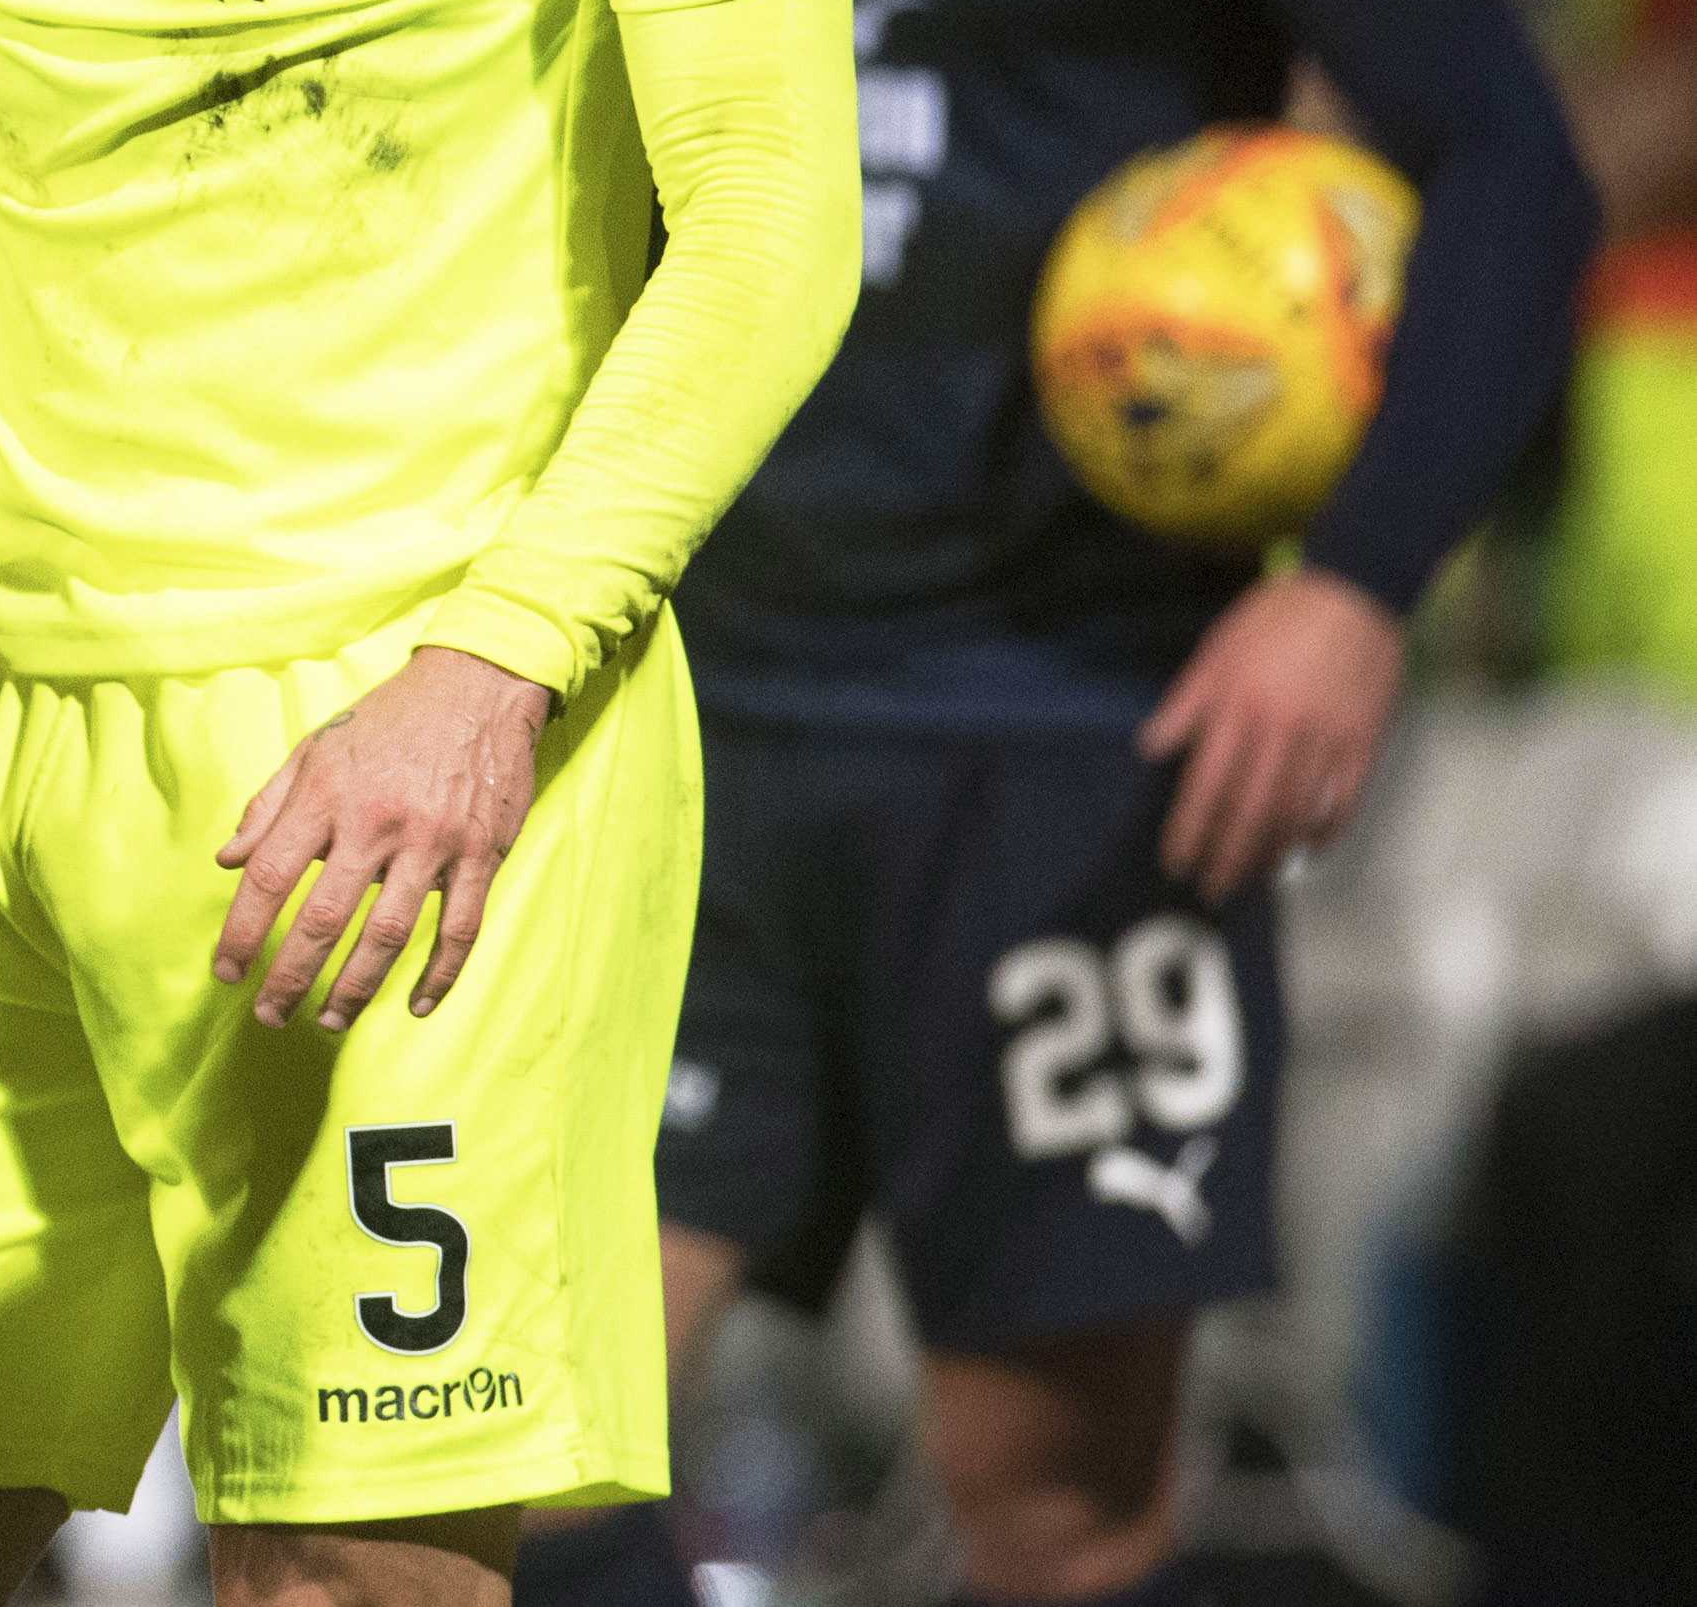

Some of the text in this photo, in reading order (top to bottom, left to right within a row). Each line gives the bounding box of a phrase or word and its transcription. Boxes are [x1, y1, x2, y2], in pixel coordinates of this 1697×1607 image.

[988, 914, 1246, 1160] 29
[344, 1120, 472, 1357] 5
[317, 1367, 524, 1424] macron
